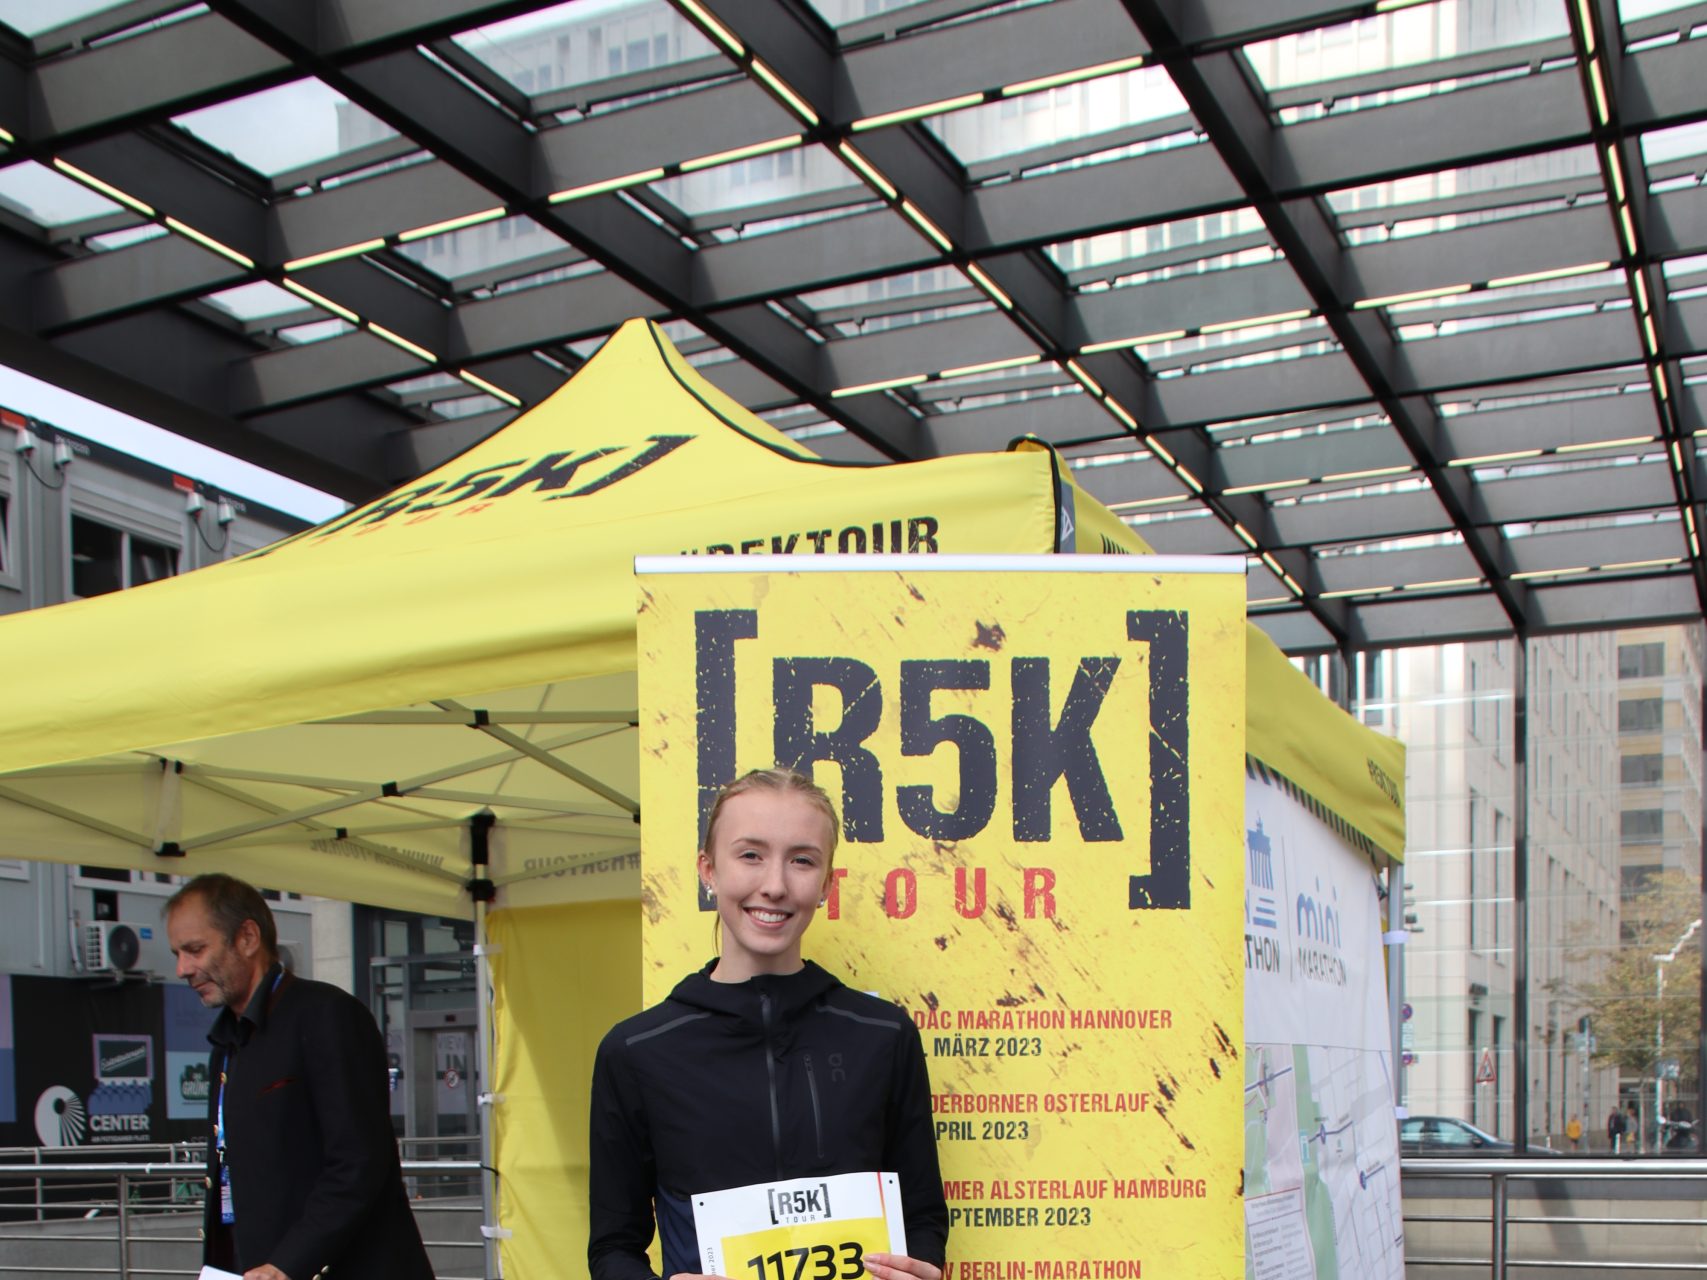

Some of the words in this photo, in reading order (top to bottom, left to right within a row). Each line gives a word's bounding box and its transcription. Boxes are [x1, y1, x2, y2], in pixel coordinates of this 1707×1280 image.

[827, 867, 1057, 920] TOUR
[1245, 933, 1281, 974] THON
[914, 1010, 952, 1030] DAC
[957, 1009, 1065, 1030] MARATHON
[1070, 1009, 1173, 1030] HANNOVER
[934, 1034, 990, 1057] MÄRZ
[995, 1037, 1042, 1057] 2023
[930, 1093, 1039, 1114] DERBORNER
[1044, 1092, 1150, 1113] OSTERLAUF
[89, 1114, 150, 1131] CENTER
[936, 1121, 977, 1141] PRIL
[982, 1121, 1029, 1141] 2023
[944, 1180, 985, 1201] MER
[990, 1180, 1108, 1200] ALSTERLAUF
[1114, 1179, 1207, 1199] HAMBURG
[767, 1183, 832, 1226] [R5K]
[785, 1214, 816, 1224] TOUR
[950, 1207, 1039, 1228] PTEMBER
[1044, 1207, 1092, 1227] 2023
[960, 1260, 1142, 1280] BERLIN-MARATHON
